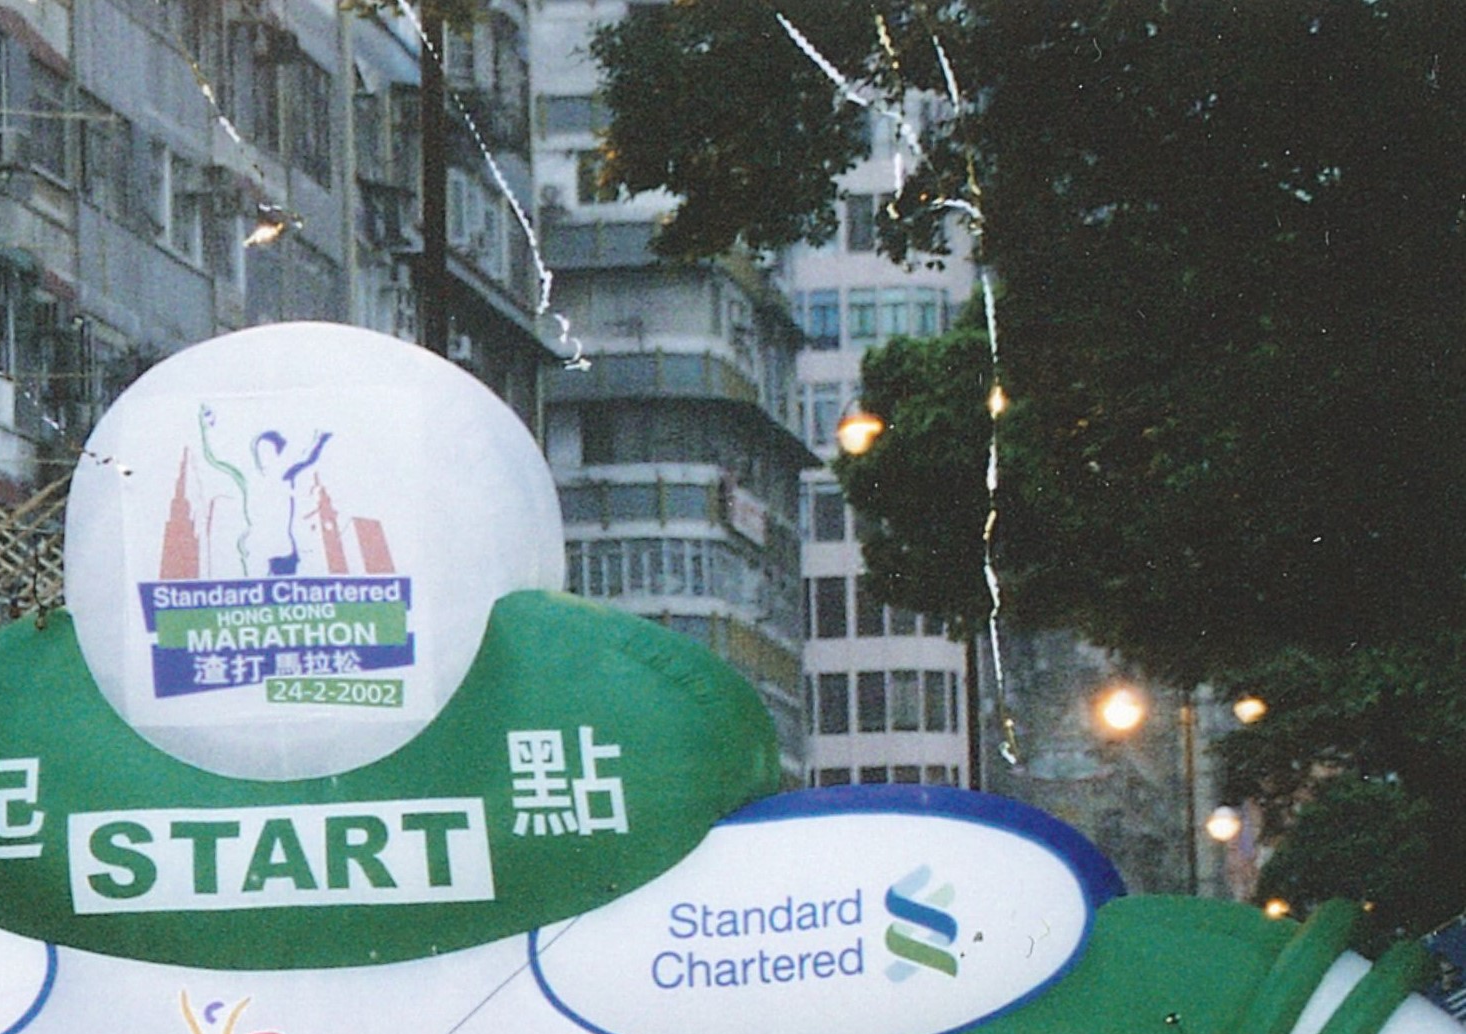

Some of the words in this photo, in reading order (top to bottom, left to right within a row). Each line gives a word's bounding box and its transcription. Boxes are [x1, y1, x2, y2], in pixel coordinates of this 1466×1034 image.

[153, 583, 264, 608] Standard
[272, 581, 401, 603] Chartered
[217, 607, 274, 627] HONG
[279, 604, 336, 621] KONG
[187, 621, 377, 652] MARATHON
[193, 653, 265, 684] 渣打
[274, 650, 363, 677] 馬拉松
[273, 682, 397, 704] 24-2-2002
[506, 725, 629, 837] 點
[86, 811, 470, 899] START
[668, 887, 863, 939] Standard
[651, 937, 865, 989] Chartered
